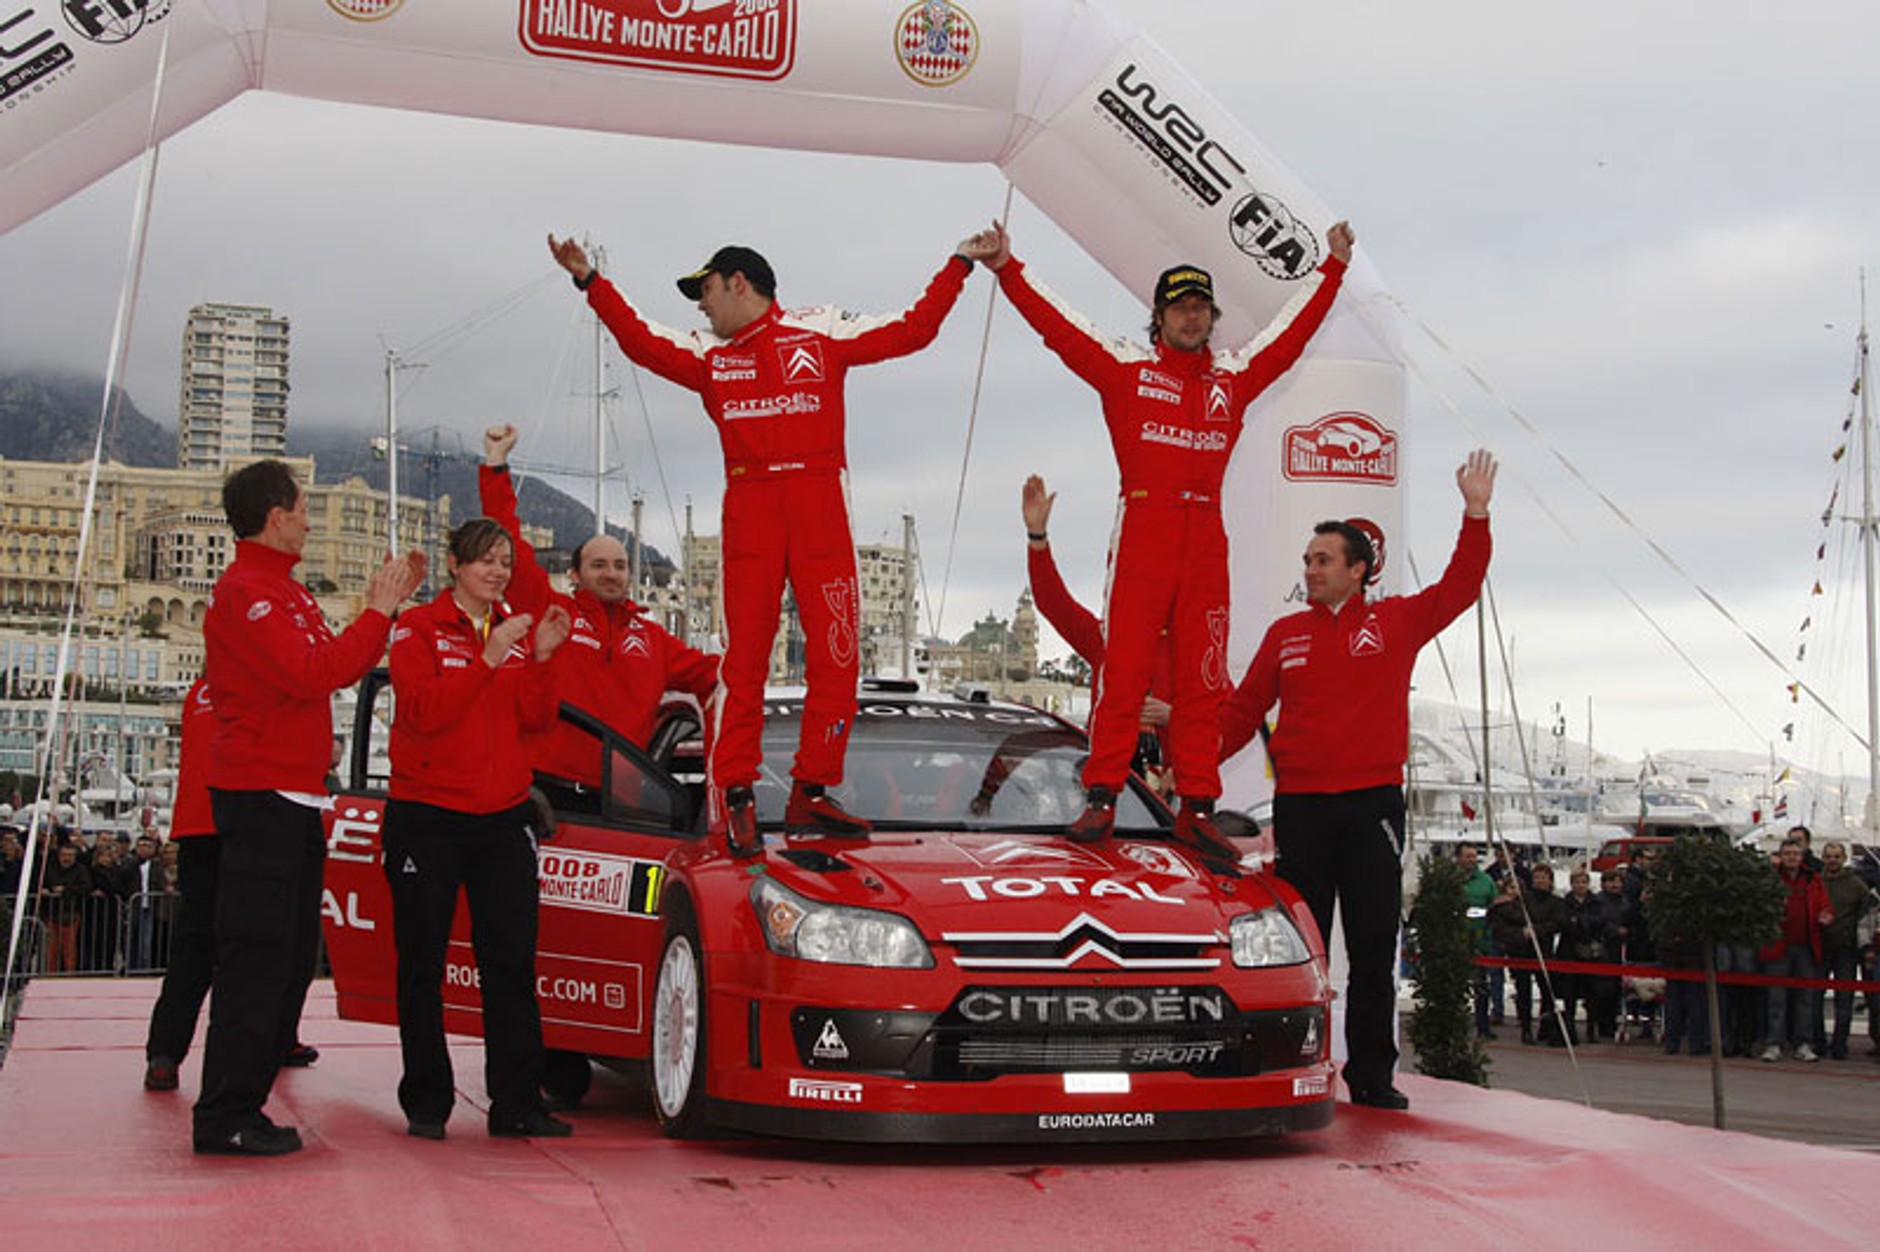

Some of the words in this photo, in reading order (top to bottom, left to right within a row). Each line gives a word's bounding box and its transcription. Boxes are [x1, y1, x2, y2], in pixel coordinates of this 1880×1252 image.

[537, 0, 615, 43] RALLYE
[621, 9, 780, 60] MONTE-CARLO
[1116, 64, 1247, 189] WRC
[1170, 156, 1218, 199] RALLY
[940, 875, 1186, 906] TOTAL
[958, 987, 1224, 1022] CITROËN
[1129, 1042, 1224, 1064] SPORT
[789, 1077, 864, 1103] PIRELLI
[1038, 1113, 1155, 1129] EURODATACAR
